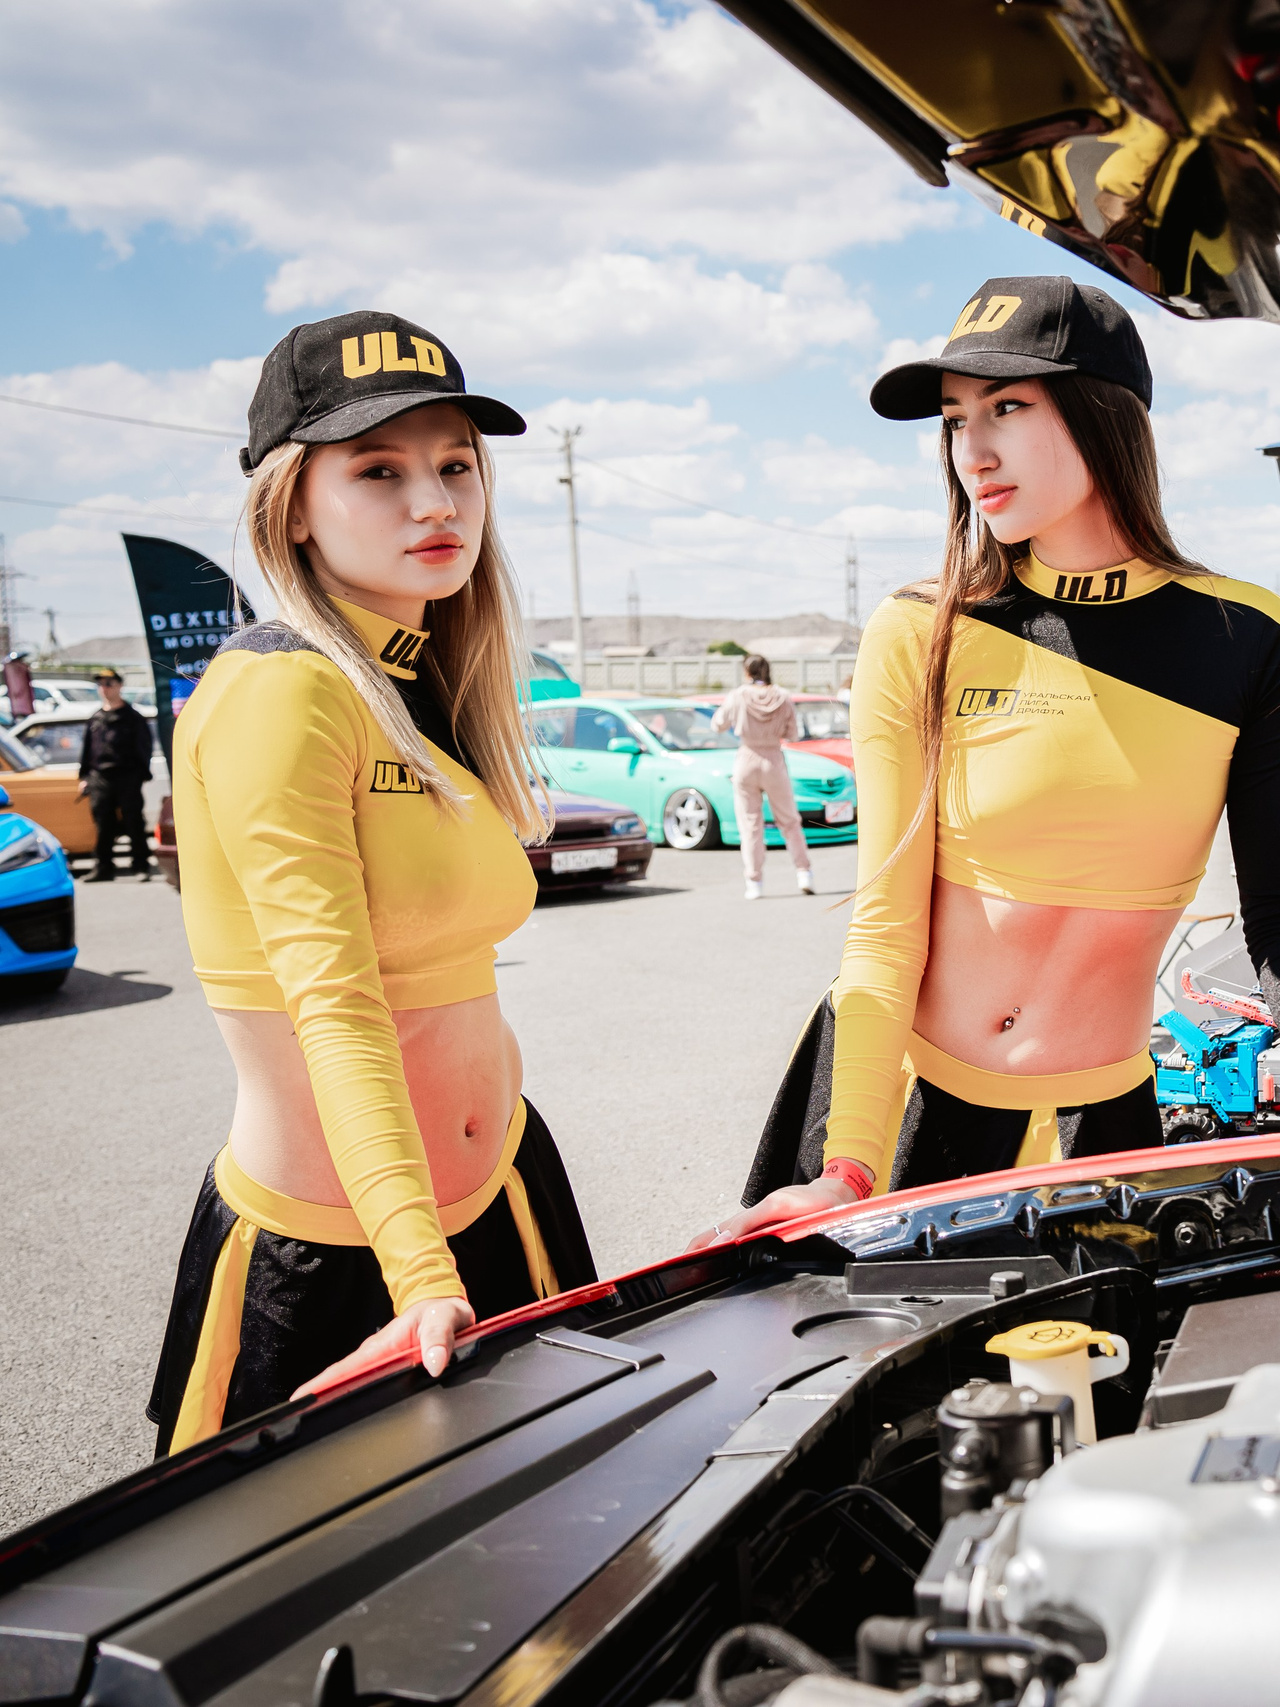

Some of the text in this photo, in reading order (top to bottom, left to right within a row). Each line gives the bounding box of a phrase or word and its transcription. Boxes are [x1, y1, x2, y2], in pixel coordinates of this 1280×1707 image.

[342, 331, 447, 379] ULD
[1054, 569, 1128, 602] ULD
[150, 610, 245, 631] DEXTE
[379, 628, 426, 672] UL
[958, 690, 1018, 716] ULD
[1023, 692, 1091, 701] УРАЛЬСКАЯ
[373, 762, 421, 793] ULD
